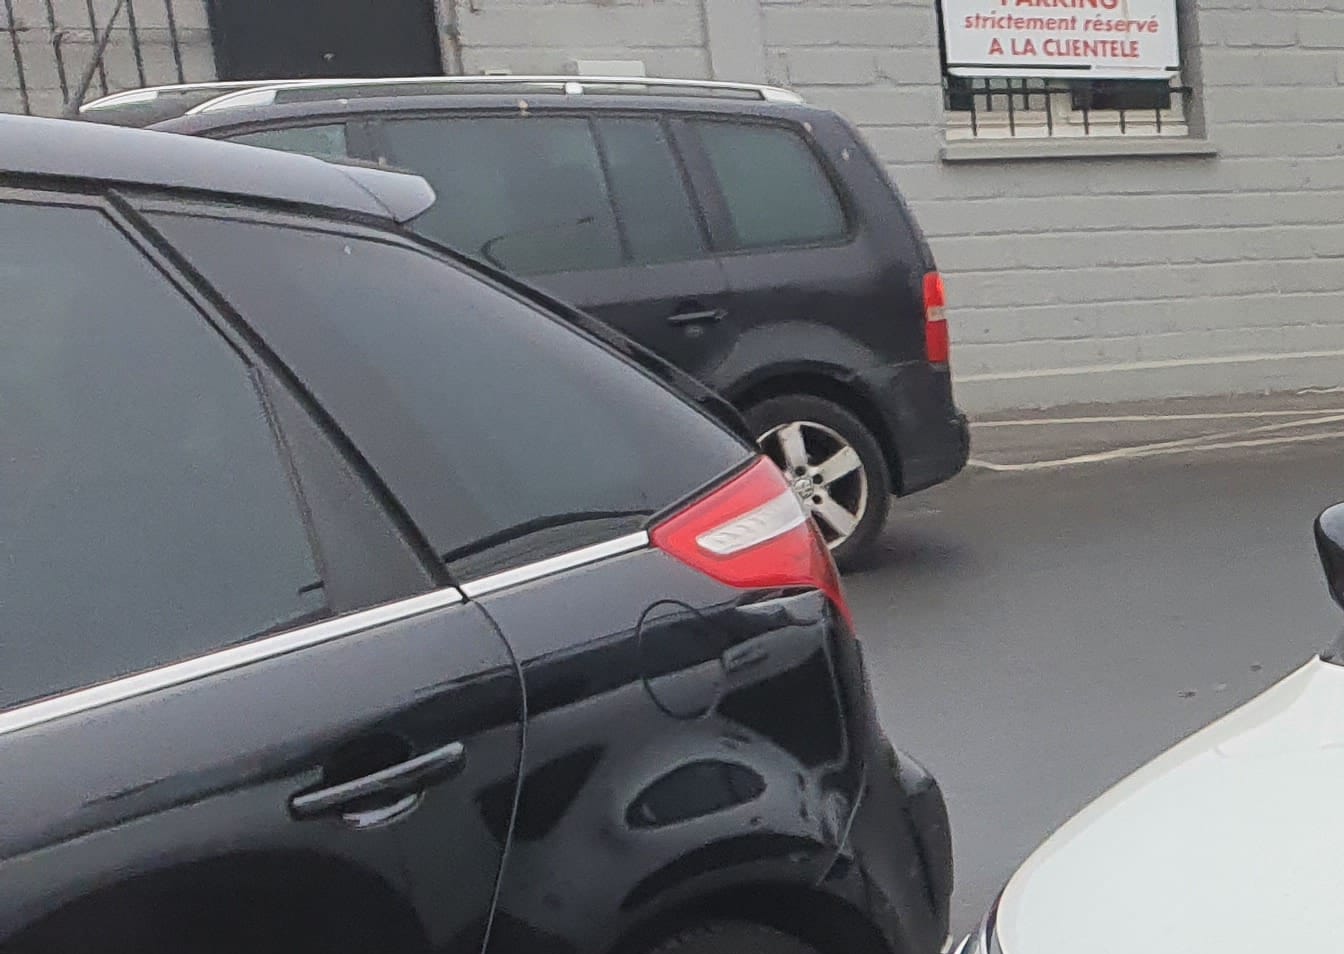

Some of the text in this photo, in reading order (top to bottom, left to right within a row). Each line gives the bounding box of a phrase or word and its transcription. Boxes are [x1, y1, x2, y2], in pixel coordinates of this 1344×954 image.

[964, 10, 1159, 33] strictement réservé
[988, 37, 1139, 58] A LA CLIENTELE
